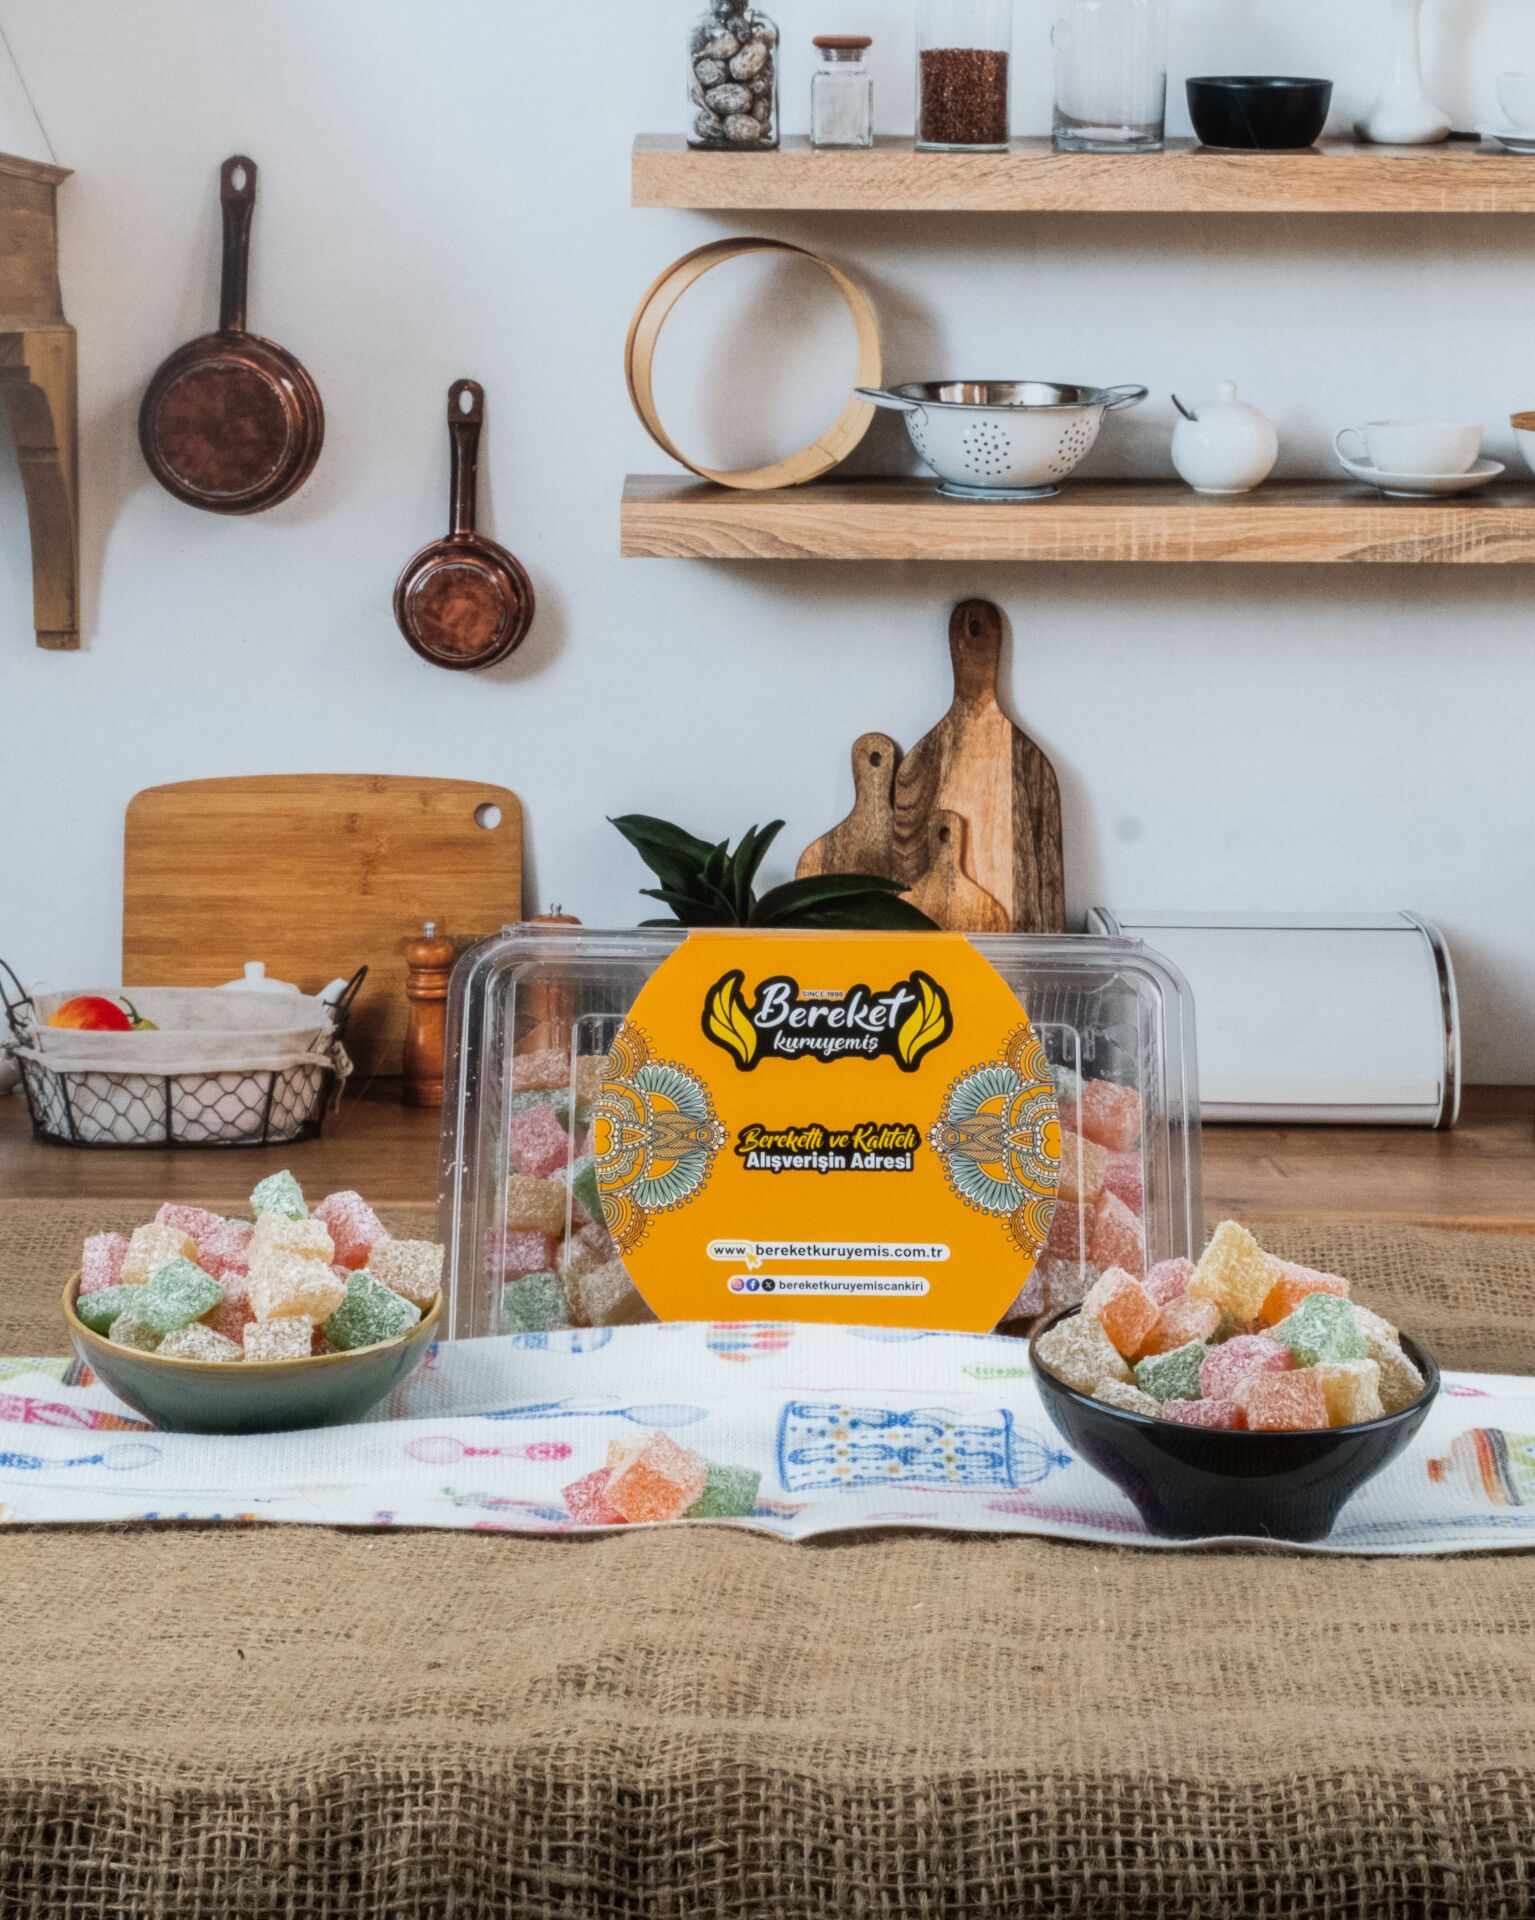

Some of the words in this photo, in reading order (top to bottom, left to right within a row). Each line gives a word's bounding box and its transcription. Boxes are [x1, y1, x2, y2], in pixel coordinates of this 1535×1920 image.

[802, 990, 825, 998] SINCE
[754, 982, 915, 1032] Bereket
[774, 1029, 879, 1056] kuruyemiş
[829, 1134, 849, 1148] ve
[852, 1126, 918, 1153] Kaliteli
[746, 1151, 846, 1172] Alışverişin
[851, 1152, 912, 1169] Adresi
[713, 1246, 746, 1255] www
[755, 1244, 943, 1259] bereketkuruyemis.com.tr
[779, 1280, 923, 1292] bereketkuruyemiscankiri
